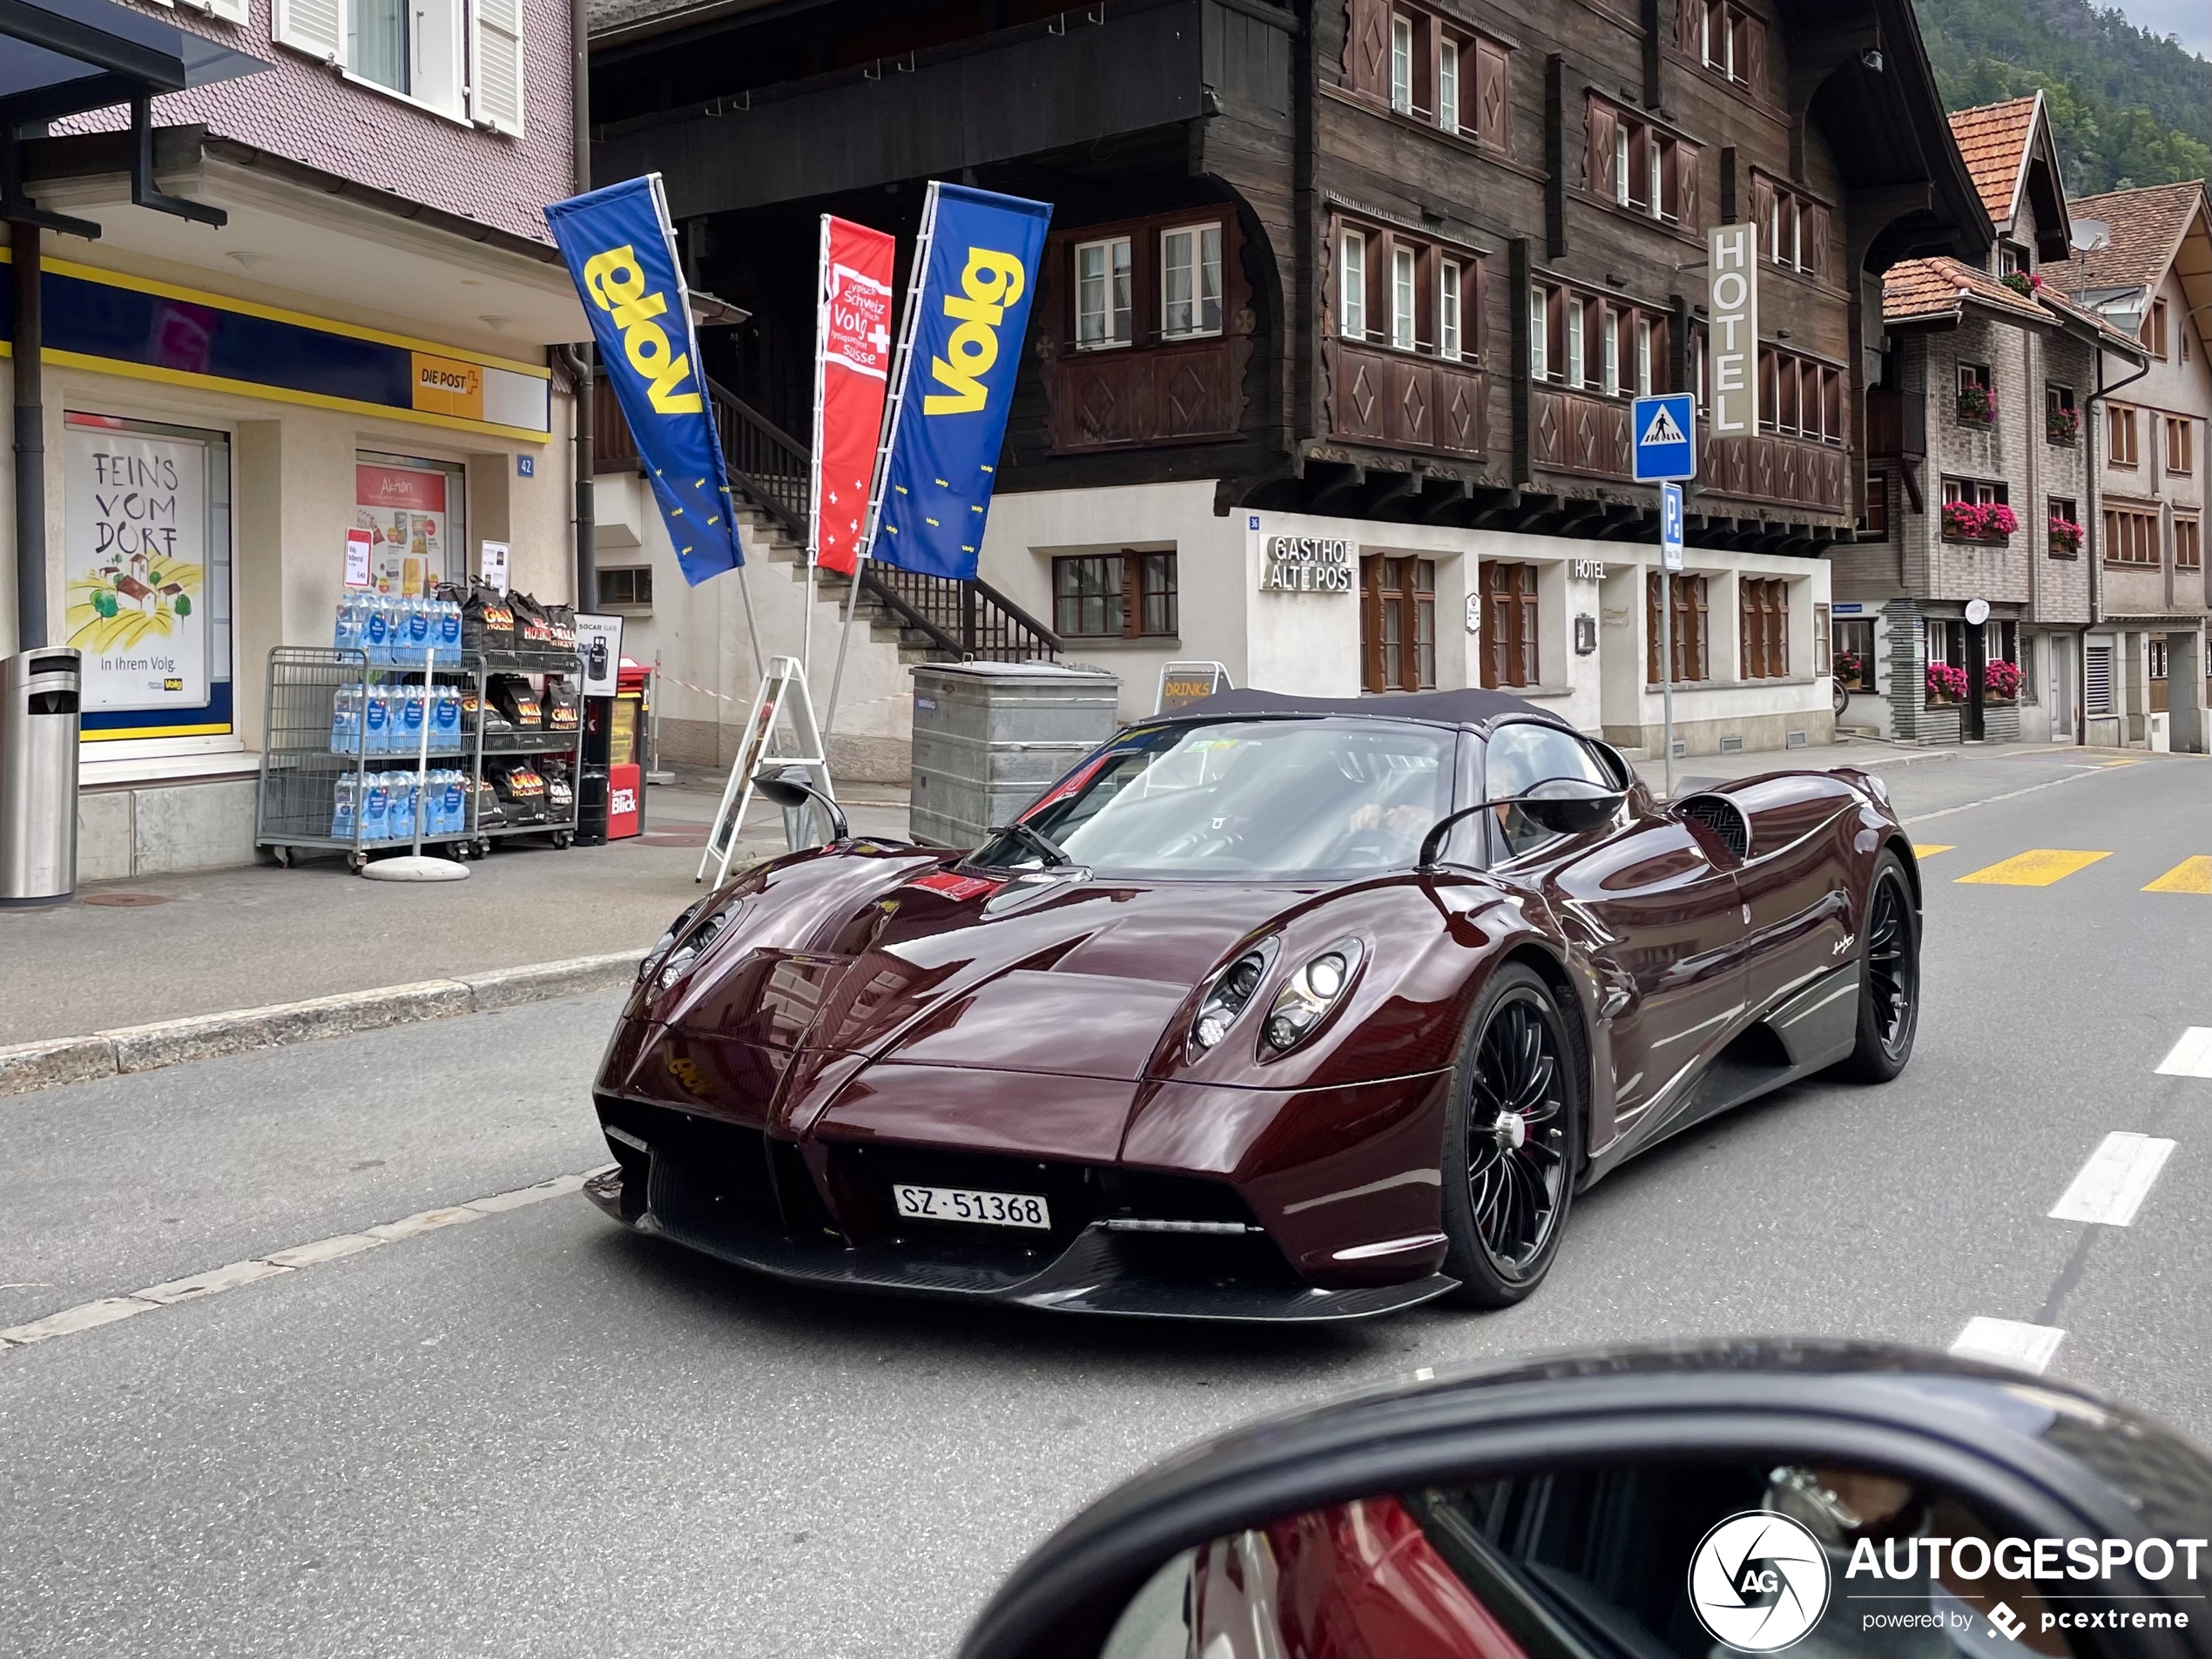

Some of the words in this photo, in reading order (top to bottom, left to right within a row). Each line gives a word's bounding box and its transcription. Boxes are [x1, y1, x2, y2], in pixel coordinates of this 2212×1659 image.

[843, 290, 886, 314] Schweiz
[834, 304, 868, 341] Volg
[923, 246, 1026, 415] Volg
[1712, 231, 1748, 431] HOTEL
[421, 368, 439, 385] DIE
[440, 372, 467, 390] POST
[521, 460, 531, 473] 42
[381, 476, 413, 496] Aktion
[95, 493, 177, 524] VOM
[1251, 518, 1258, 529] 36
[95, 521, 178, 557] DORF
[1274, 536, 1353, 563] GASTHOF
[1270, 564, 1311, 589] ALTE
[1316, 566, 1358, 590] POST
[1575, 558, 1608, 579] HOTEL
[101, 657, 111, 671] In
[115, 656, 148, 671] Ihrem
[165, 679, 182, 691] Volg
[1165, 682, 1211, 697] DRINKS
[611, 788, 634, 798] Sonntags
[611, 793, 637, 815] Blick
